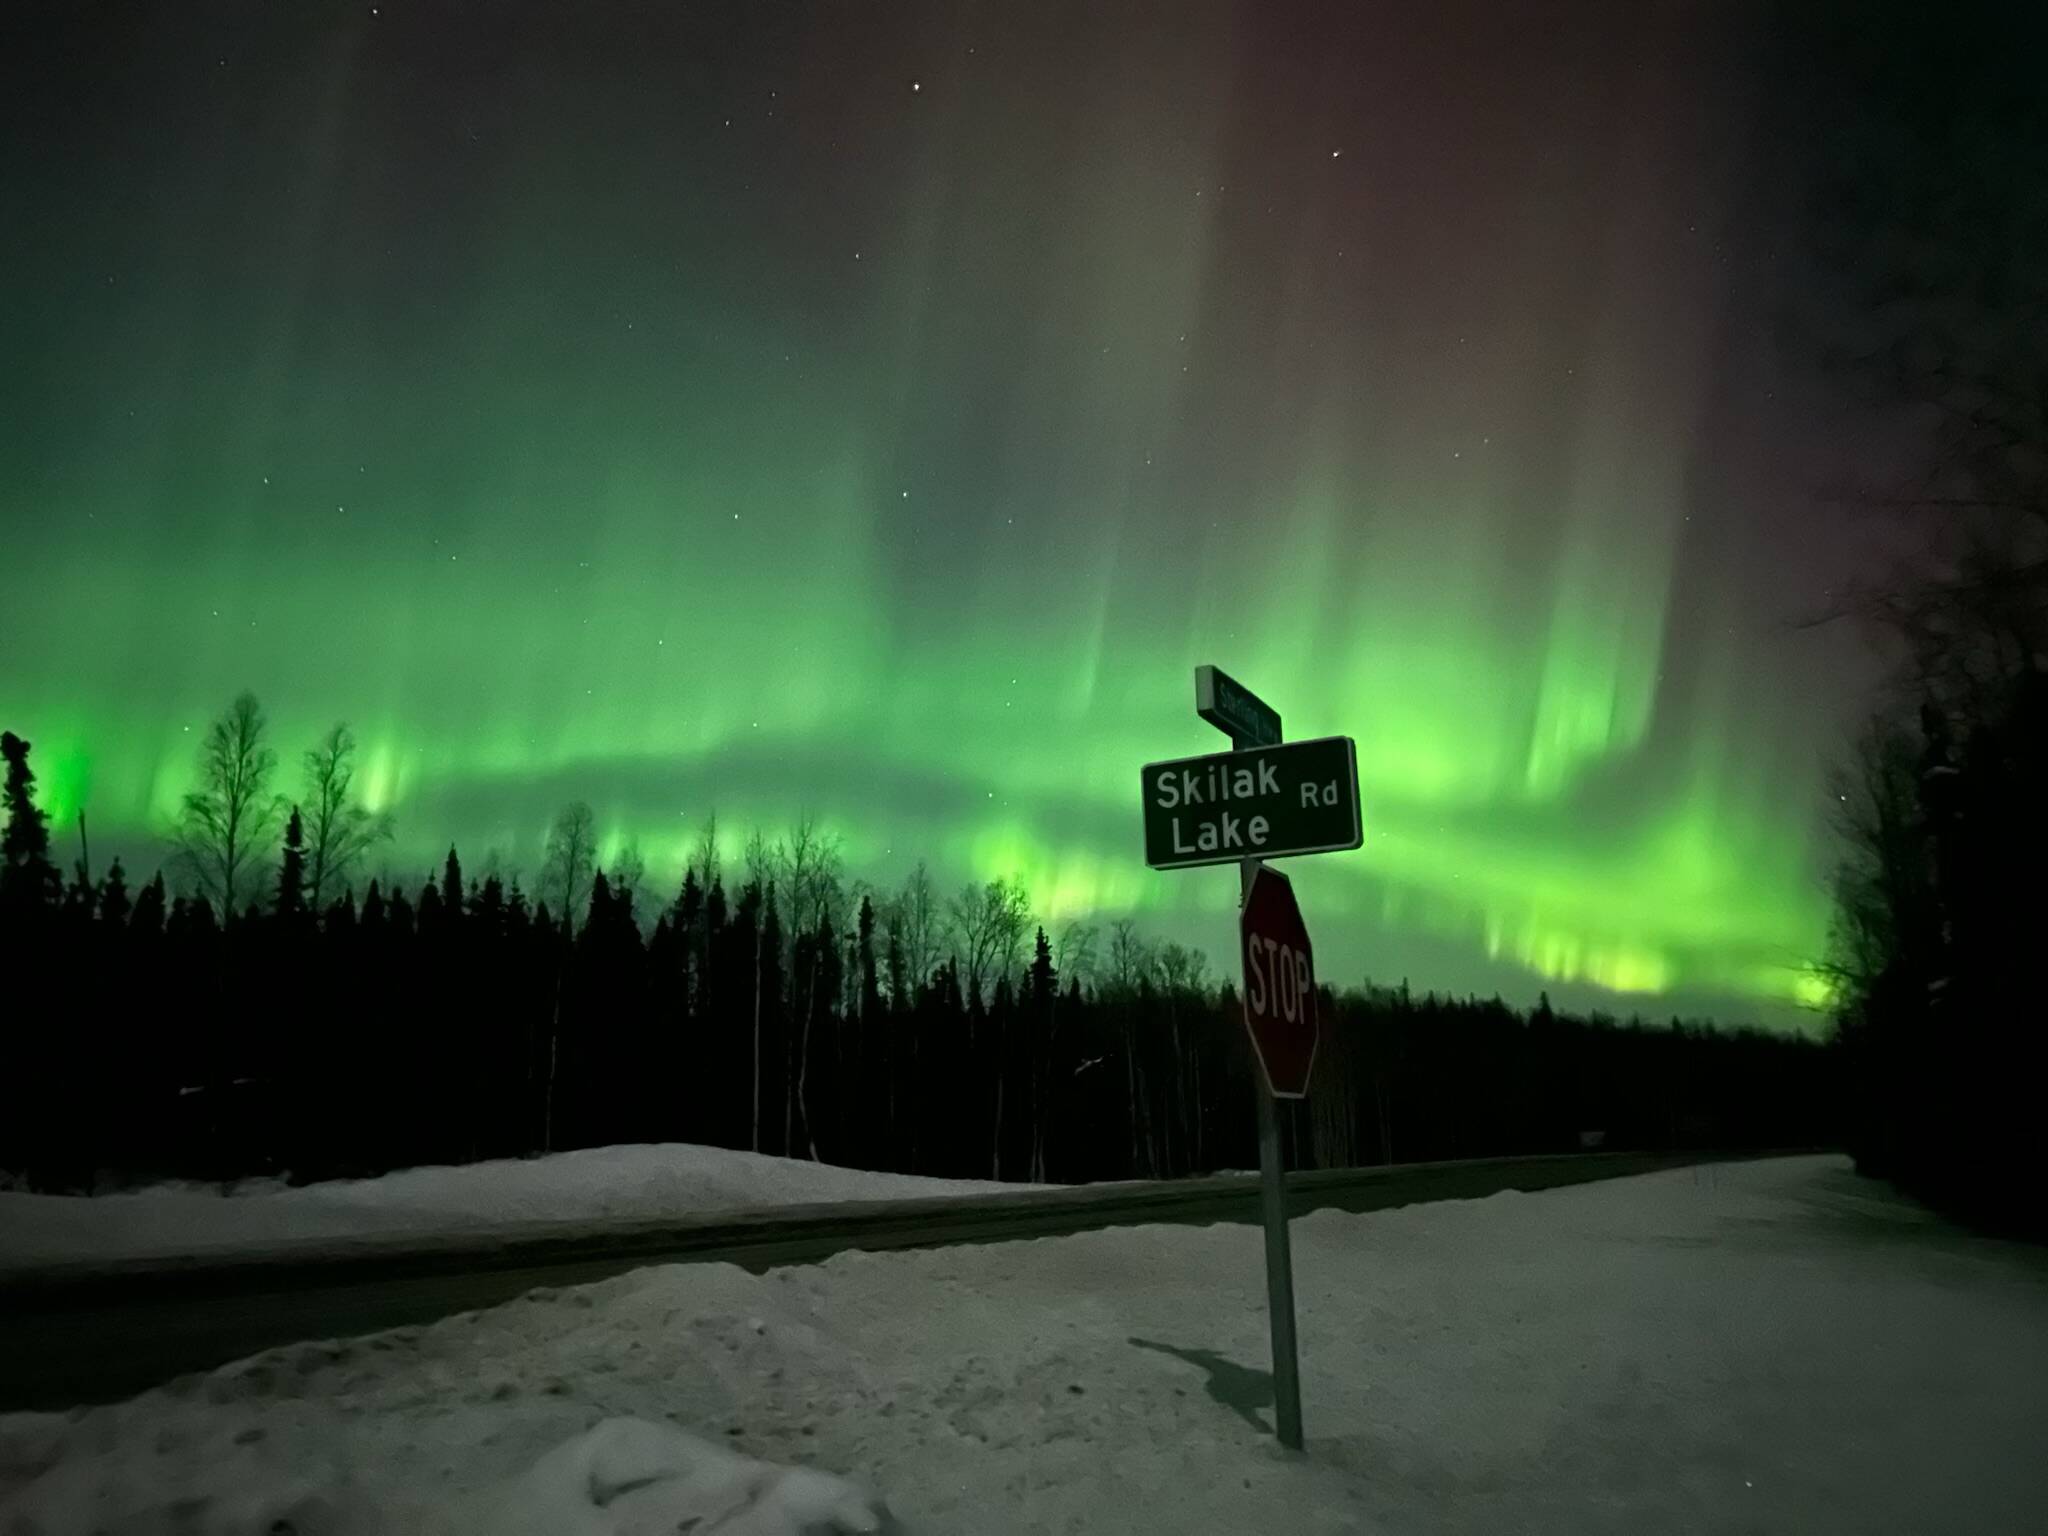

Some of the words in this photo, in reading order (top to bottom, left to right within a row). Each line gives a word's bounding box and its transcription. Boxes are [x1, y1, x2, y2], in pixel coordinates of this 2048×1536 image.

[1157, 759, 1281, 808] Skilak
[1300, 780, 1338, 808] Rd
[1172, 812, 1270, 854] Lake
[1249, 933, 1310, 1024] STOP
